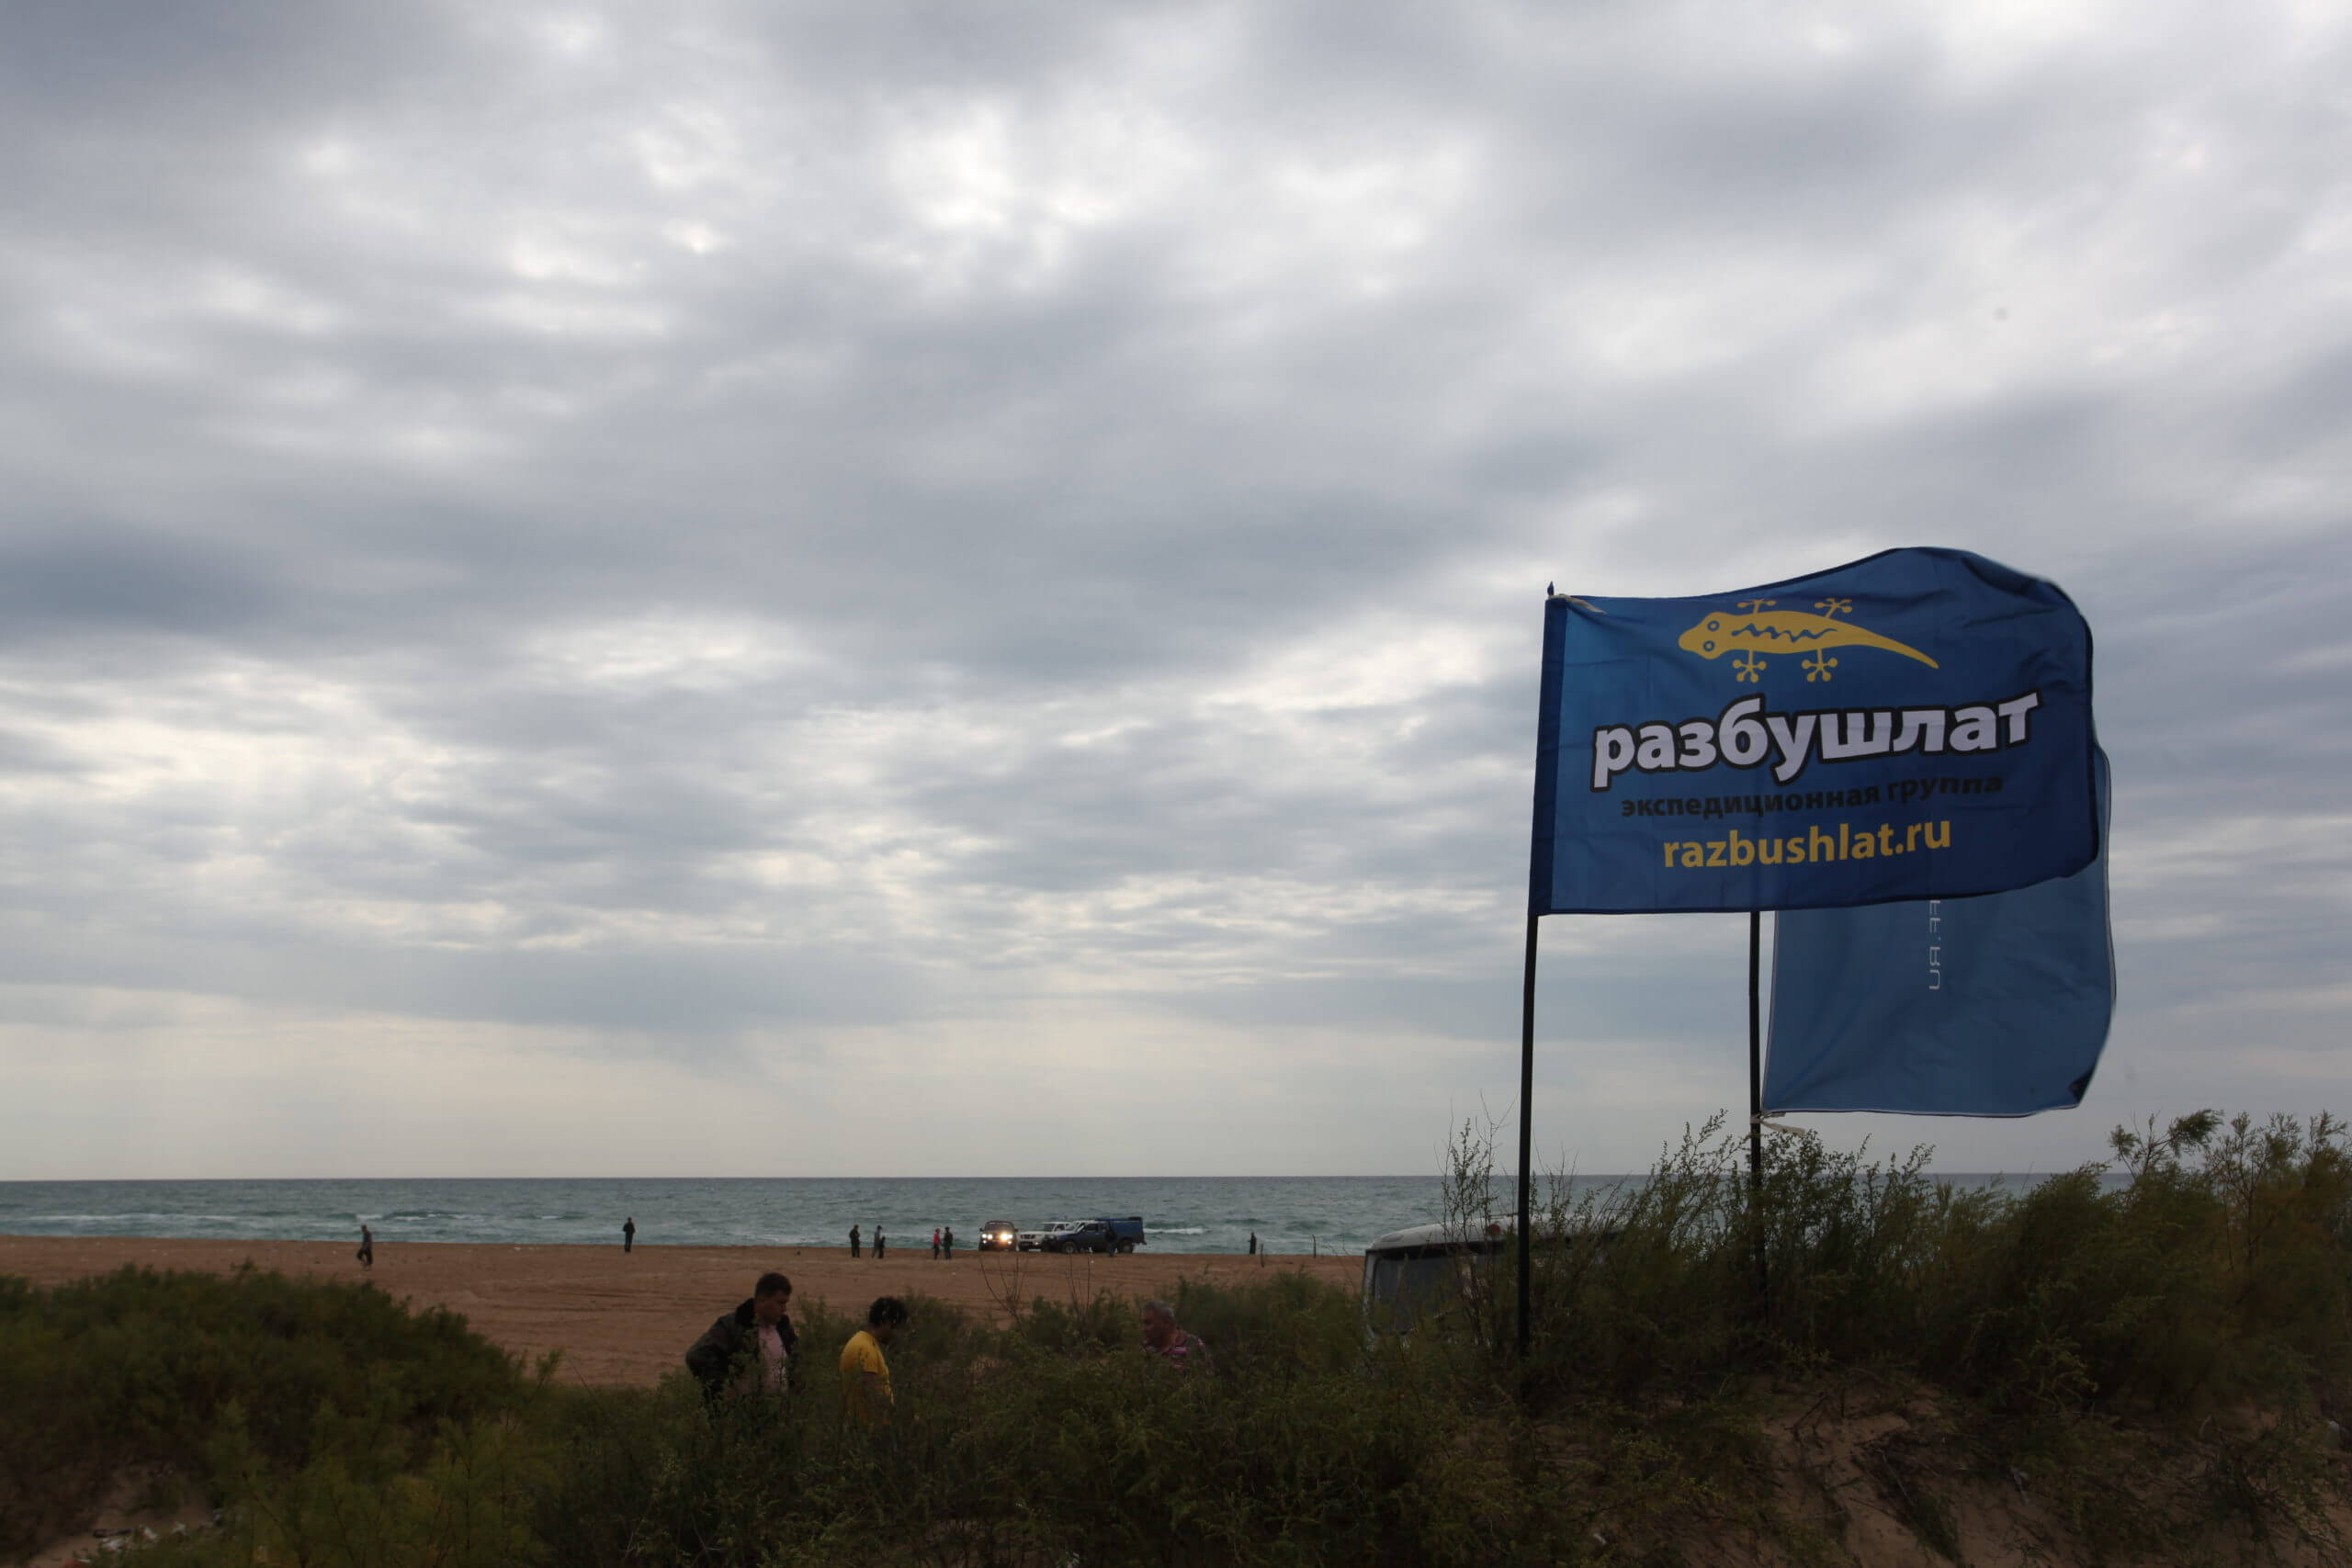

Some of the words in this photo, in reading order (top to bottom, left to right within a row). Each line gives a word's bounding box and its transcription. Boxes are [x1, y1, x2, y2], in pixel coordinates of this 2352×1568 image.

[1591, 690, 2041, 790] разбушлат
[1621, 784, 1881, 819] экспедиционная
[1887, 776, 2004, 806] группа
[1663, 819, 1951, 868] razbushlat.ru
